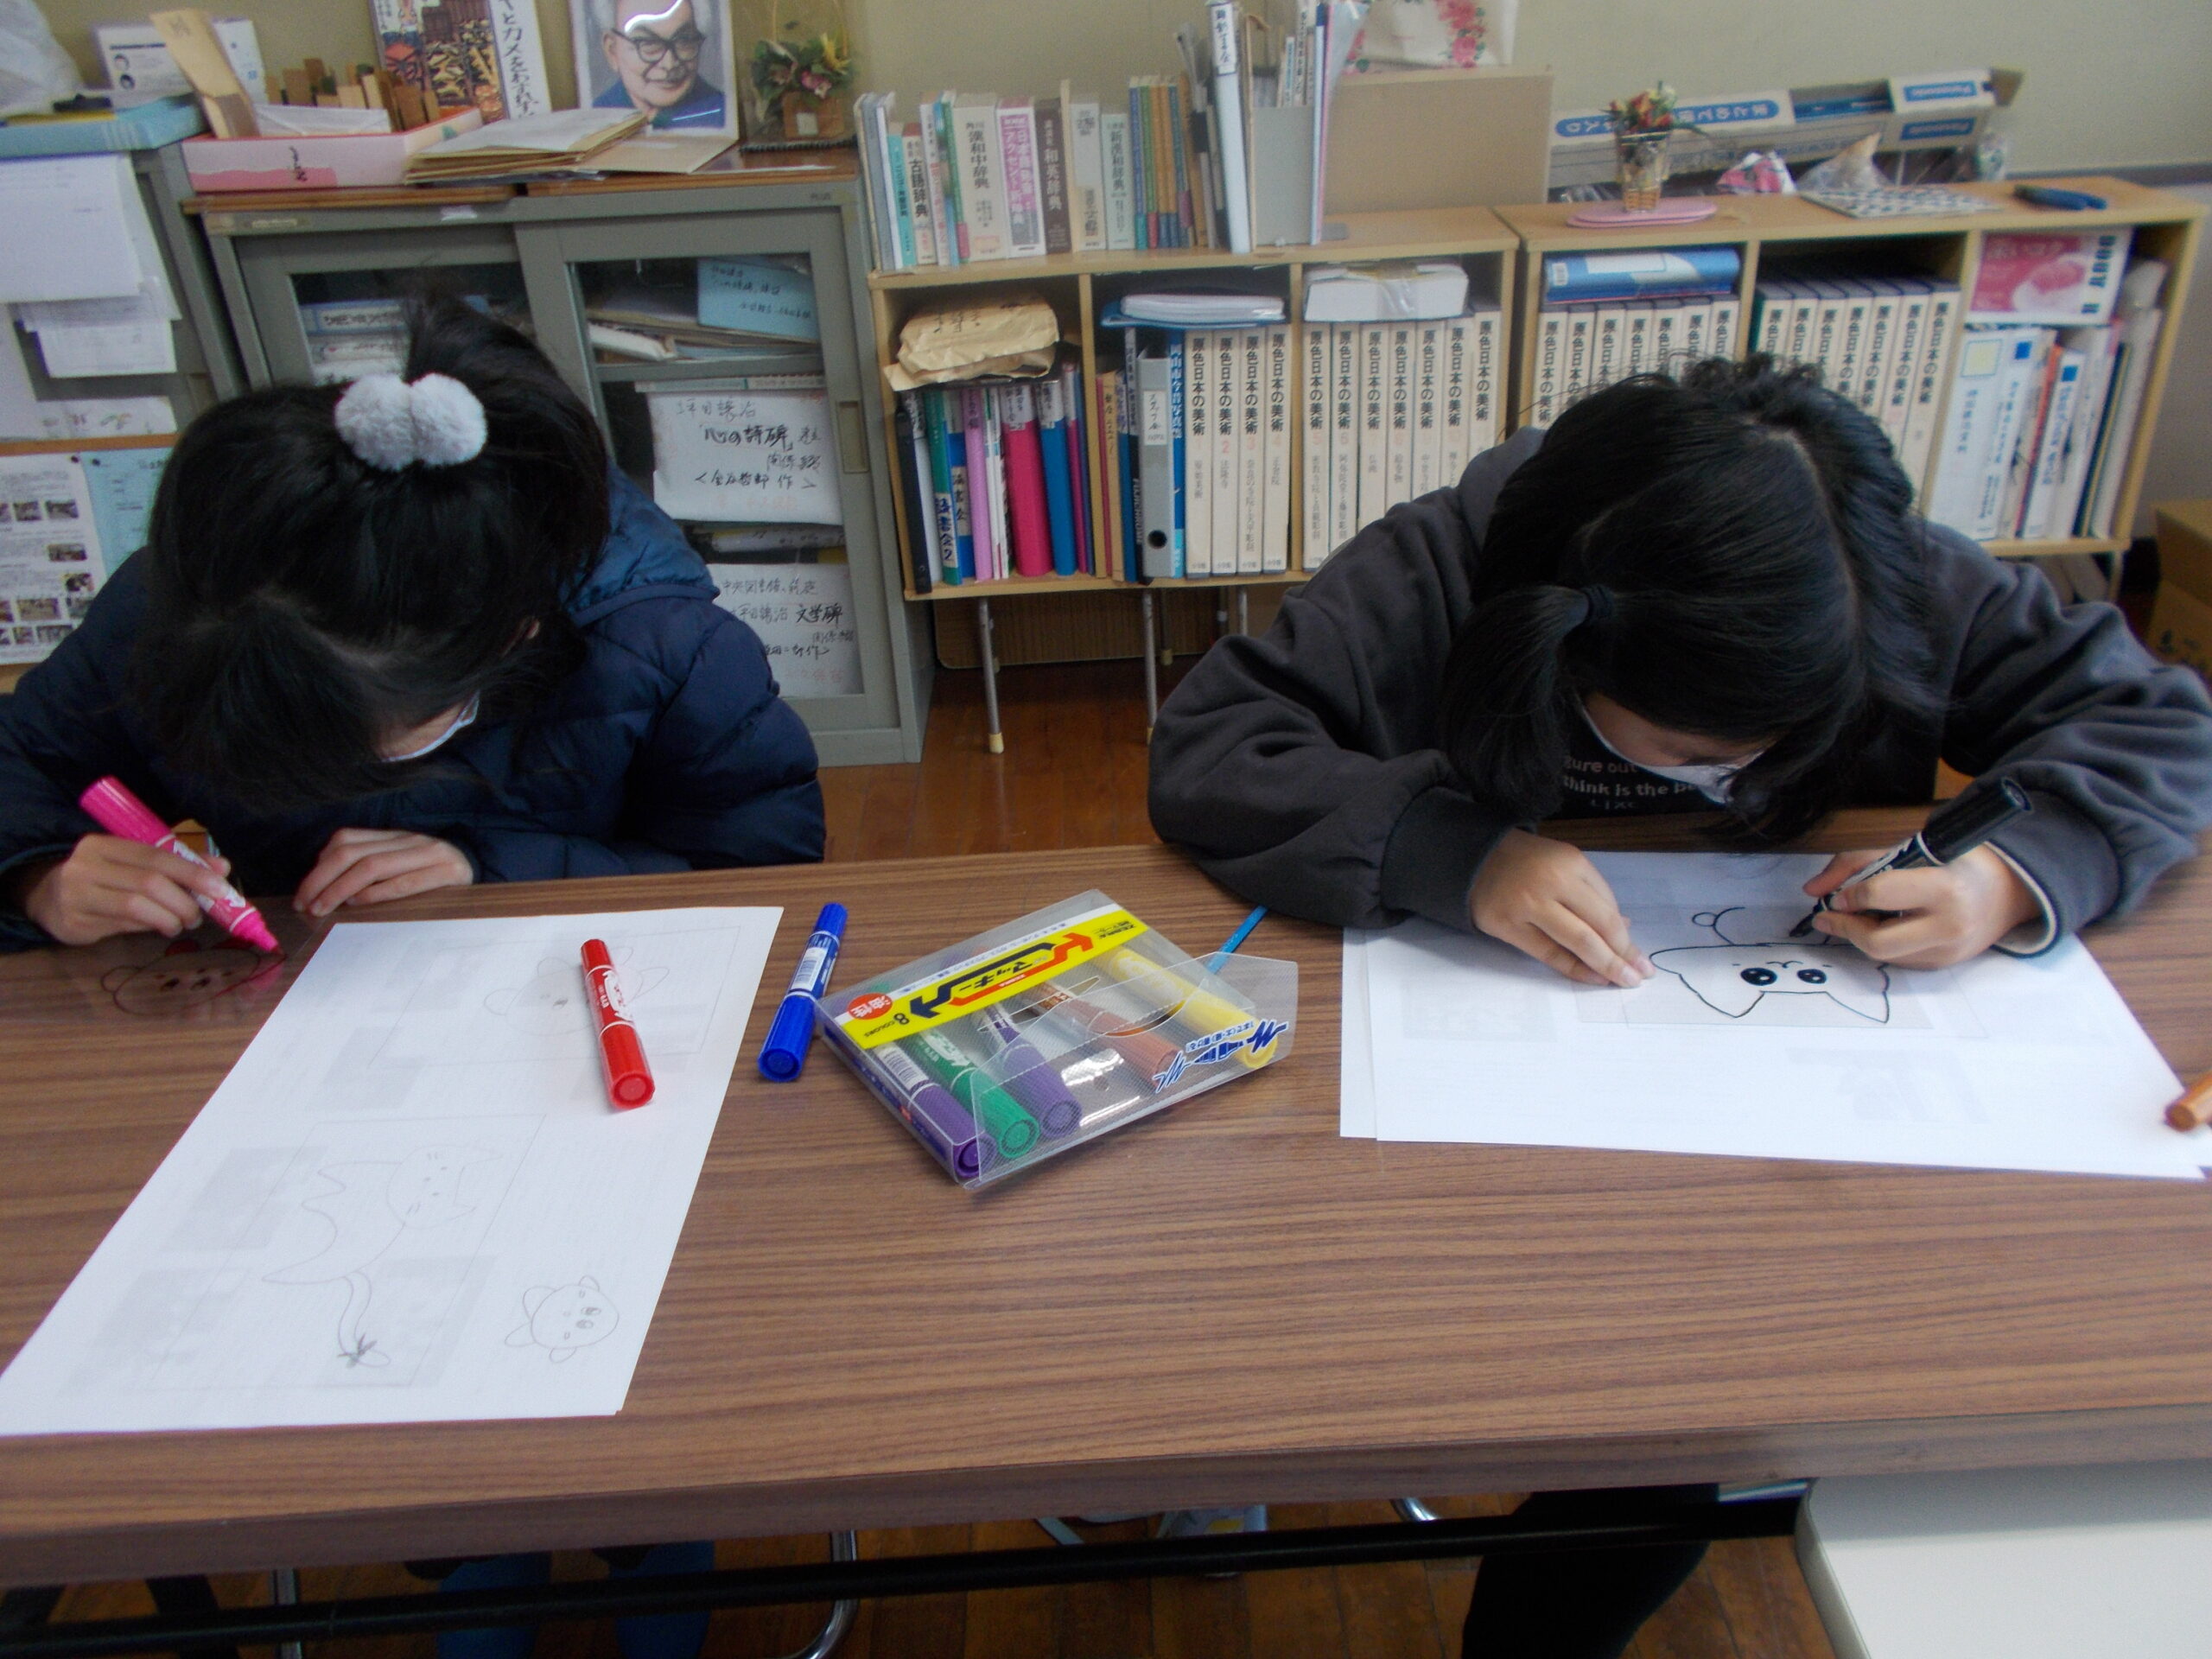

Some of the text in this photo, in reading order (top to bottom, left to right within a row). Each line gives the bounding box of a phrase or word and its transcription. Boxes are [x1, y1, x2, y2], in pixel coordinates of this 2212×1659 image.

[909, 159, 929, 218] 古語辞典
[1192, 338, 1205, 435] 原色日本の美術
[1219, 337, 1232, 435] 原色日本の美術
[1246, 337, 1259, 435] 原色日本の美術
[1271, 334, 1285, 433] 原色日本の美術
[1309, 331, 1323, 430] 原色日本の美術
[1338, 331, 1351, 430] 原色日本の美術
[1368, 331, 1382, 431] 原色日本の美術
[1394, 331, 1408, 430] 原色日本の美術
[1421, 330, 1436, 430] 原色日本の美術
[1447, 327, 1465, 426] 原色日本の美術
[1475, 321, 1493, 422] 原色日本の美術
[1538, 321, 1560, 423] 原色日本の美術
[1562, 775, 1610, 796] think
[1615, 784, 1631, 797] is
[1636, 783, 1669, 797] the
[849, 993, 893, 1020] 油性
[893, 1011, 909, 1027] 8
[959, 961, 1033, 992] マッキー
